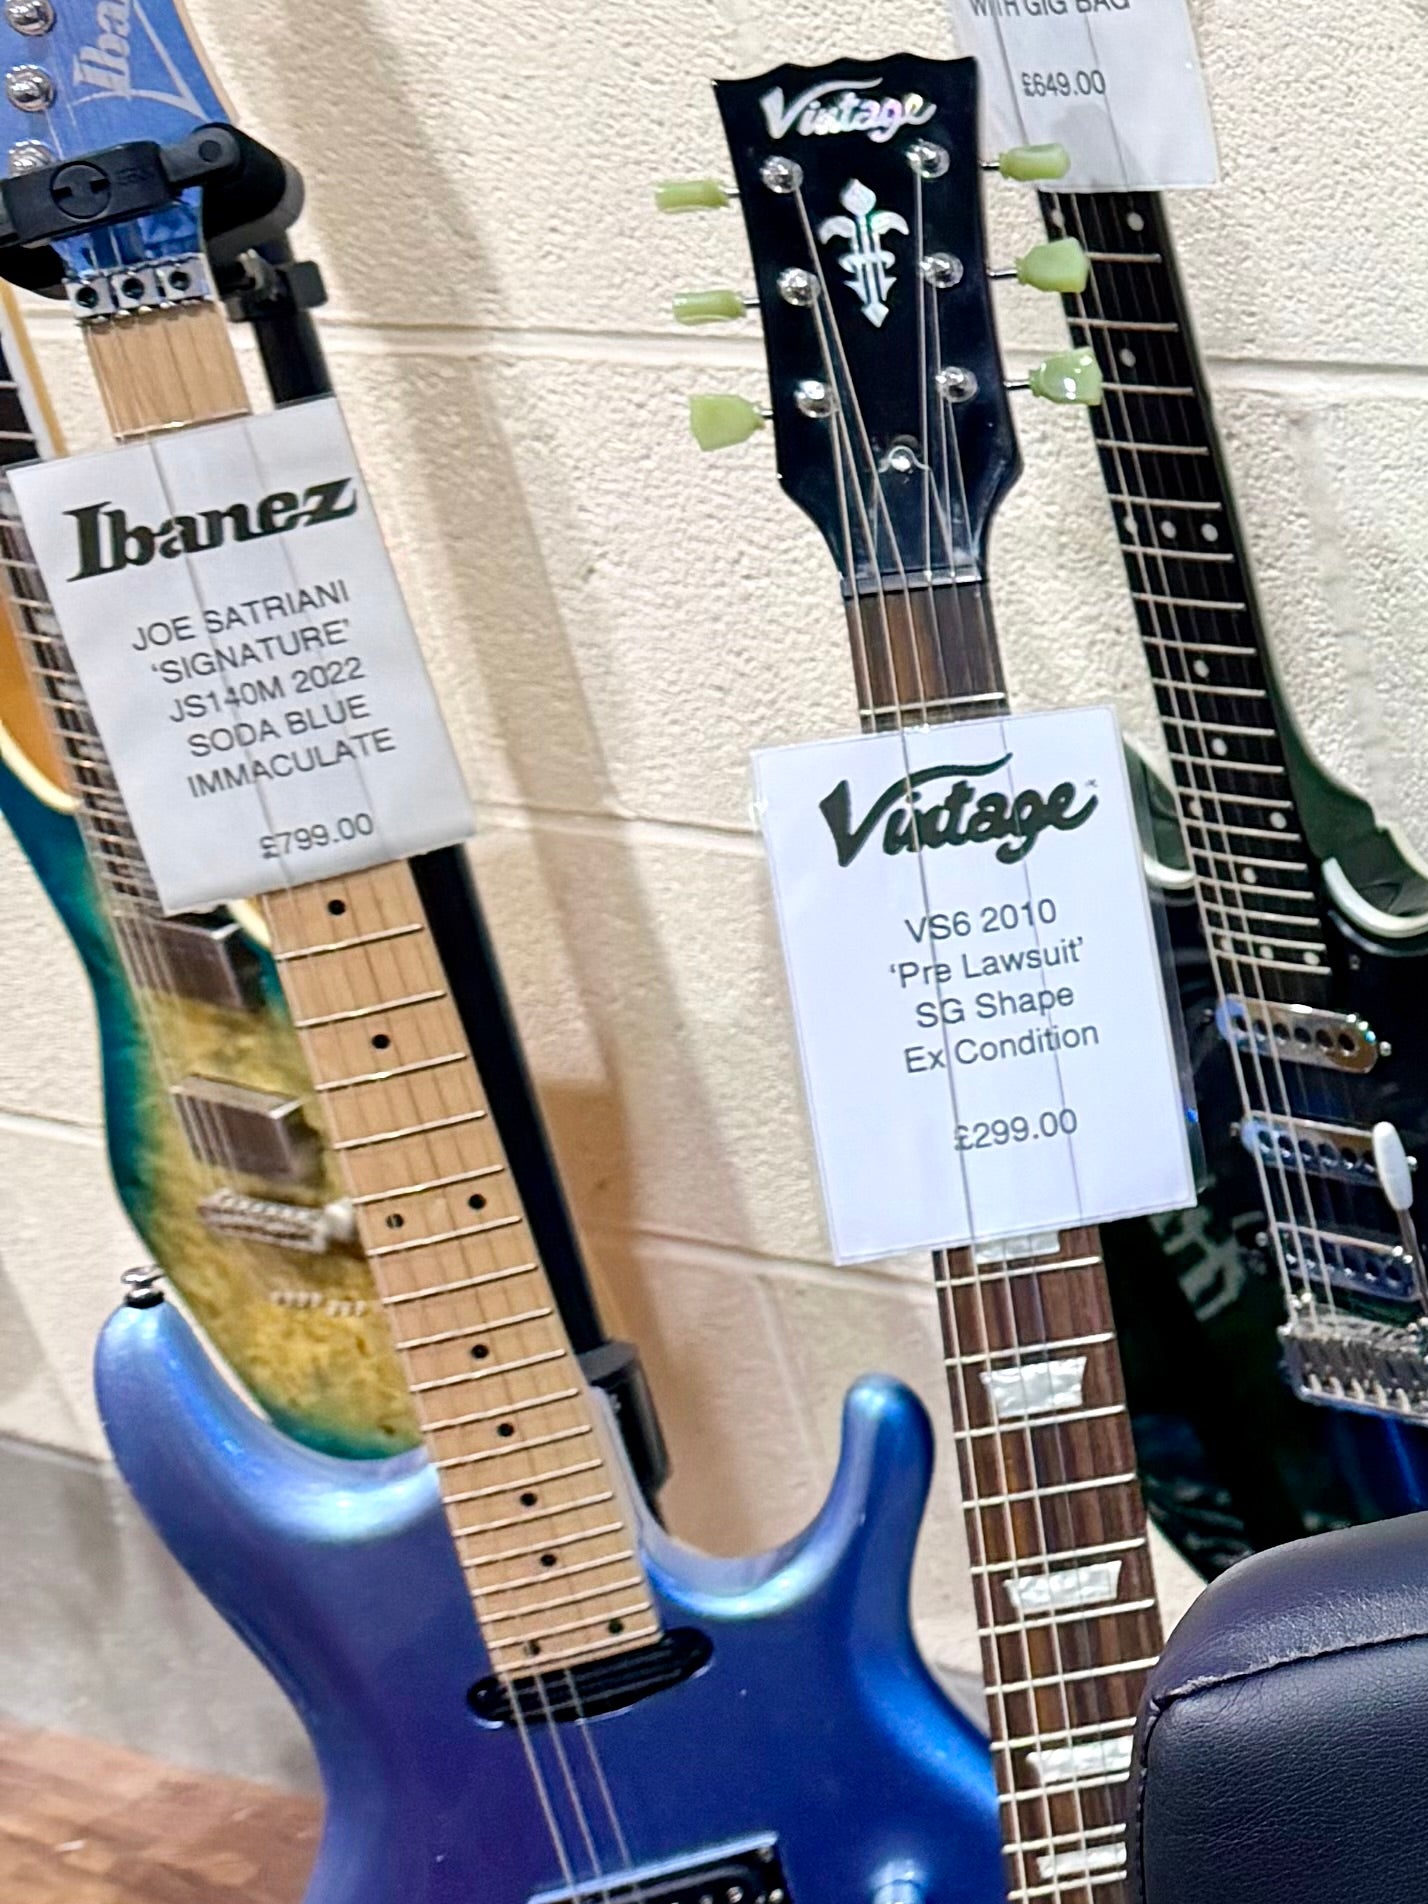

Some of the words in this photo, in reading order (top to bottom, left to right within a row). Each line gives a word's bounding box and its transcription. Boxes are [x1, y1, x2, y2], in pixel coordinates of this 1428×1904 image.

[760, 77, 937, 142] Vintage
[1021, 69, 1107, 98] £649.00
[63, 476, 359, 583] Ibanez
[131, 614, 197, 652] JOE
[203, 578, 350, 635] SATRIANI
[169, 675, 286, 724] JS140M
[290, 656, 367, 695] 2022
[186, 717, 282, 758] SODA
[284, 694, 372, 736] BLUE
[187, 726, 397, 799] IMMACULATE
[258, 811, 374, 861] £799.00
[818, 752, 1099, 868] Vintage
[903, 910, 972, 944] VS6
[980, 898, 1058, 934] 2010
[915, 997, 966, 1029] SG
[974, 985, 1075, 1019] Shape
[903, 1045, 947, 1074] Ex
[953, 1024, 1100, 1065] Condition
[953, 1107, 1078, 1152] £299.00
